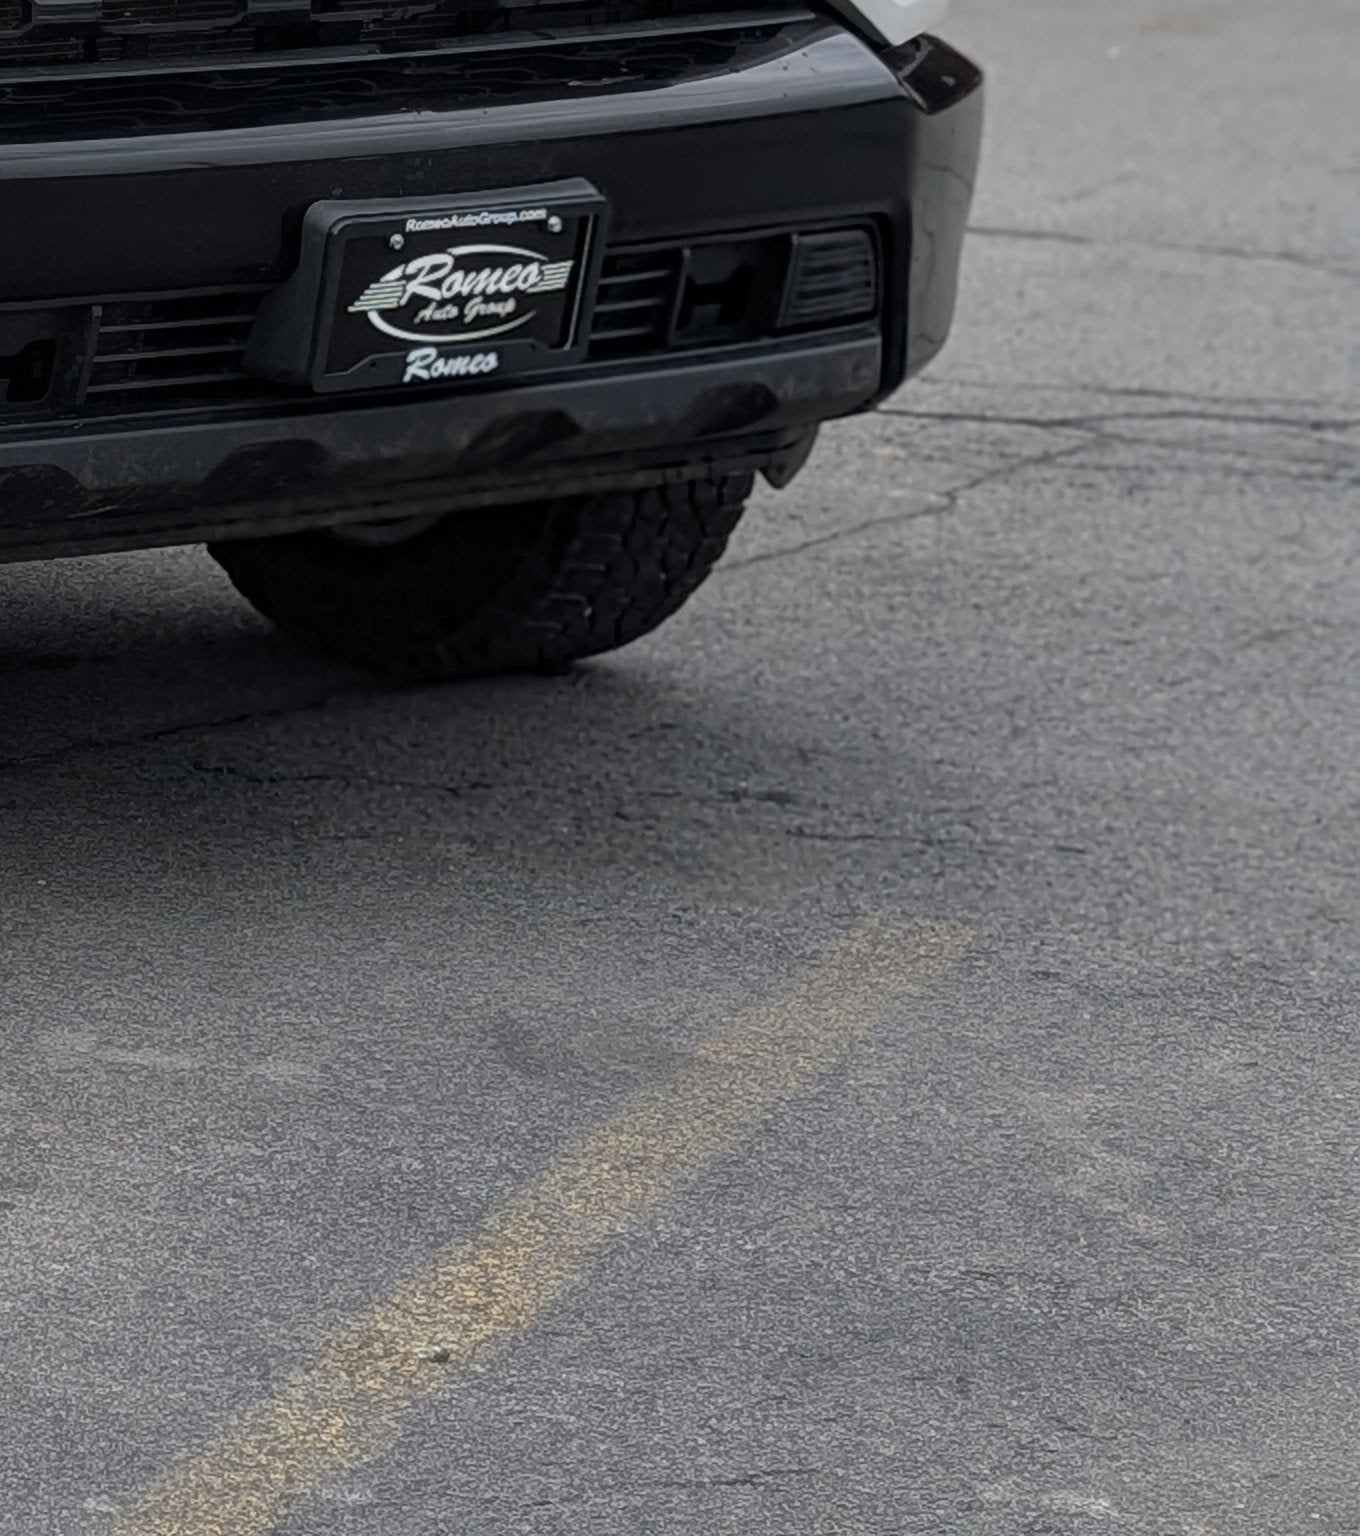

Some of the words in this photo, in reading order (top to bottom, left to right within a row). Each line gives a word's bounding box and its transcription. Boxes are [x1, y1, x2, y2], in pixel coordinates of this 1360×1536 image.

[406, 209, 547, 232] RomeoAutoGroup.com
[399, 253, 542, 306] Romeo
[414, 301, 458, 323] Auto
[463, 295, 517, 324] Group
[402, 346, 499, 383] Romeo
